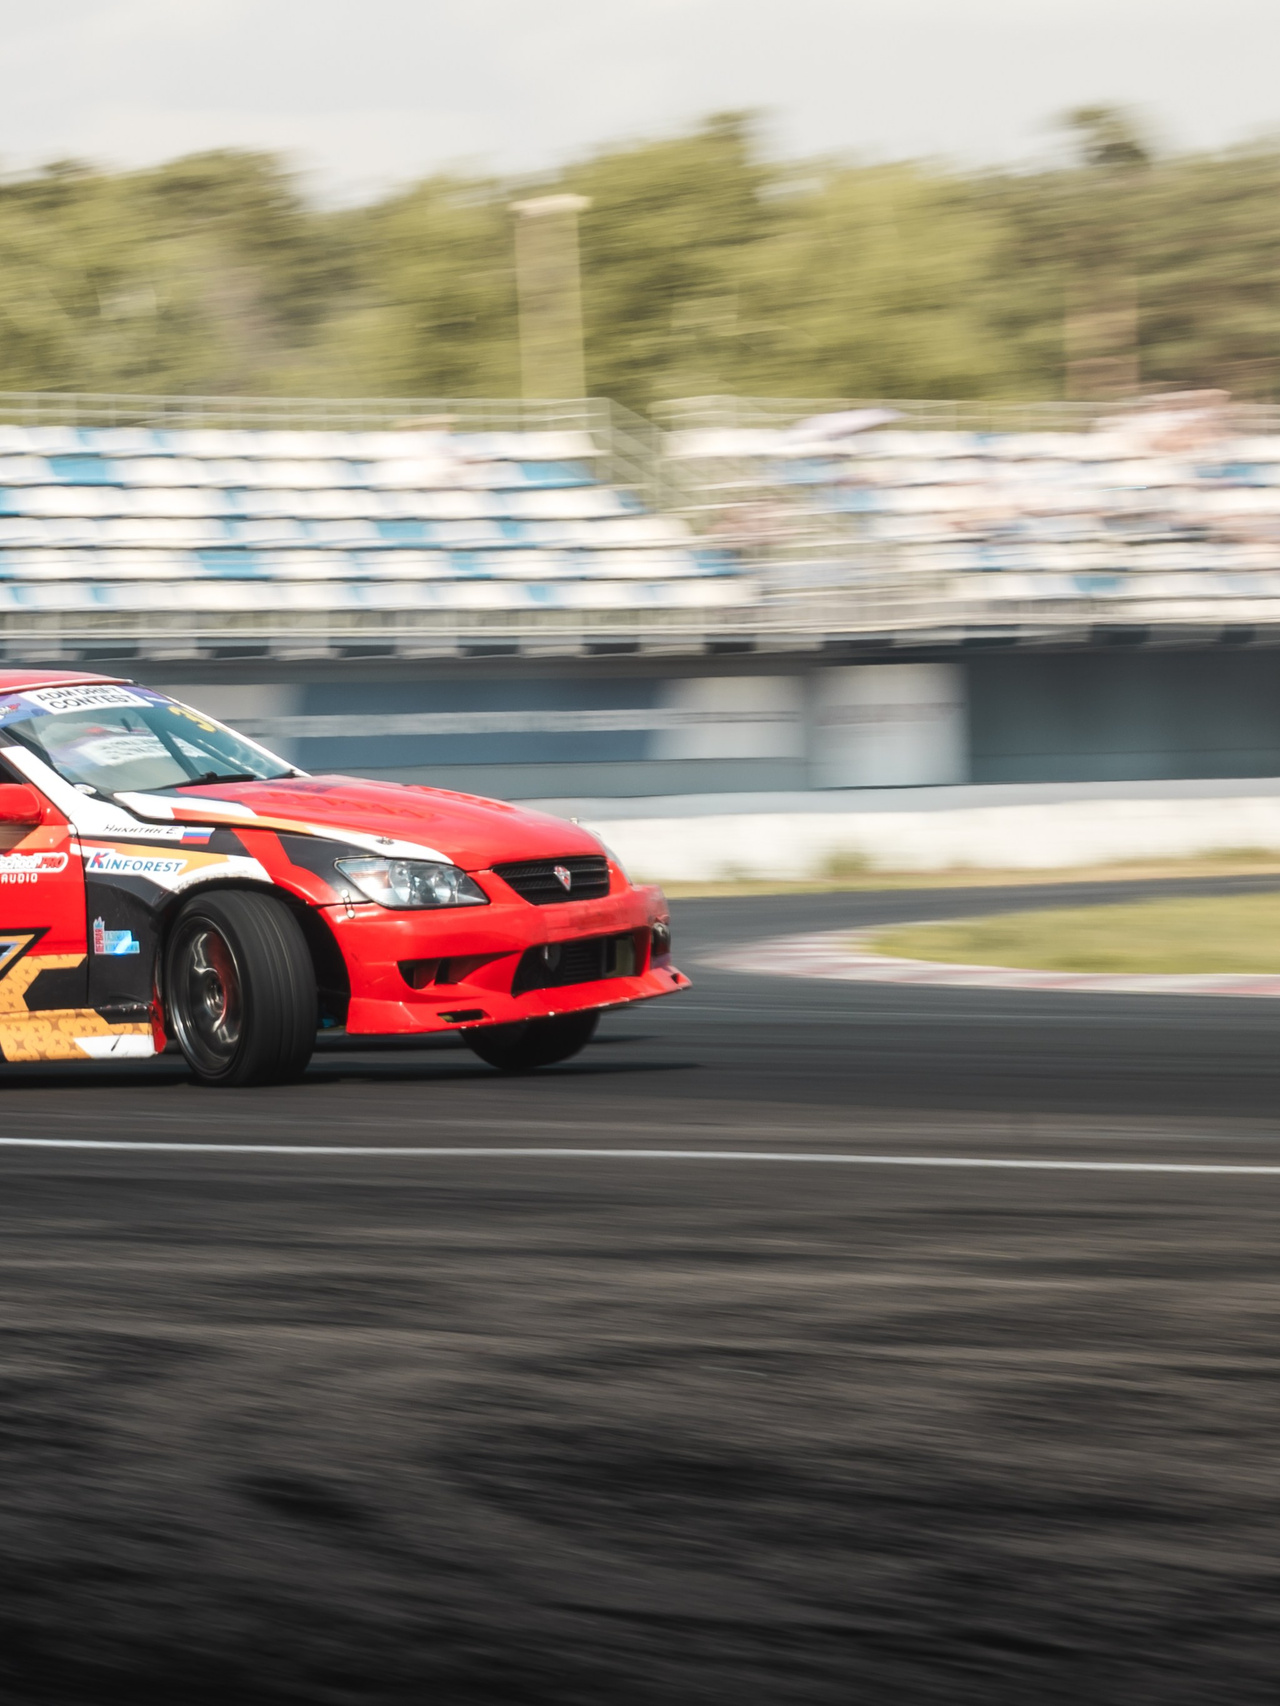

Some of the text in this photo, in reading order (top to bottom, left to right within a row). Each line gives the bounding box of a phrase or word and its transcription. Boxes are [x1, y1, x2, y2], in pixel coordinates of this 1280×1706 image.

[37, 685, 122, 702] ADM DRIFT
[49, 694, 138, 710] CONTEST
[89, 851, 184, 873] KINFOREST
[1, 872, 38, 885] AUDIO
